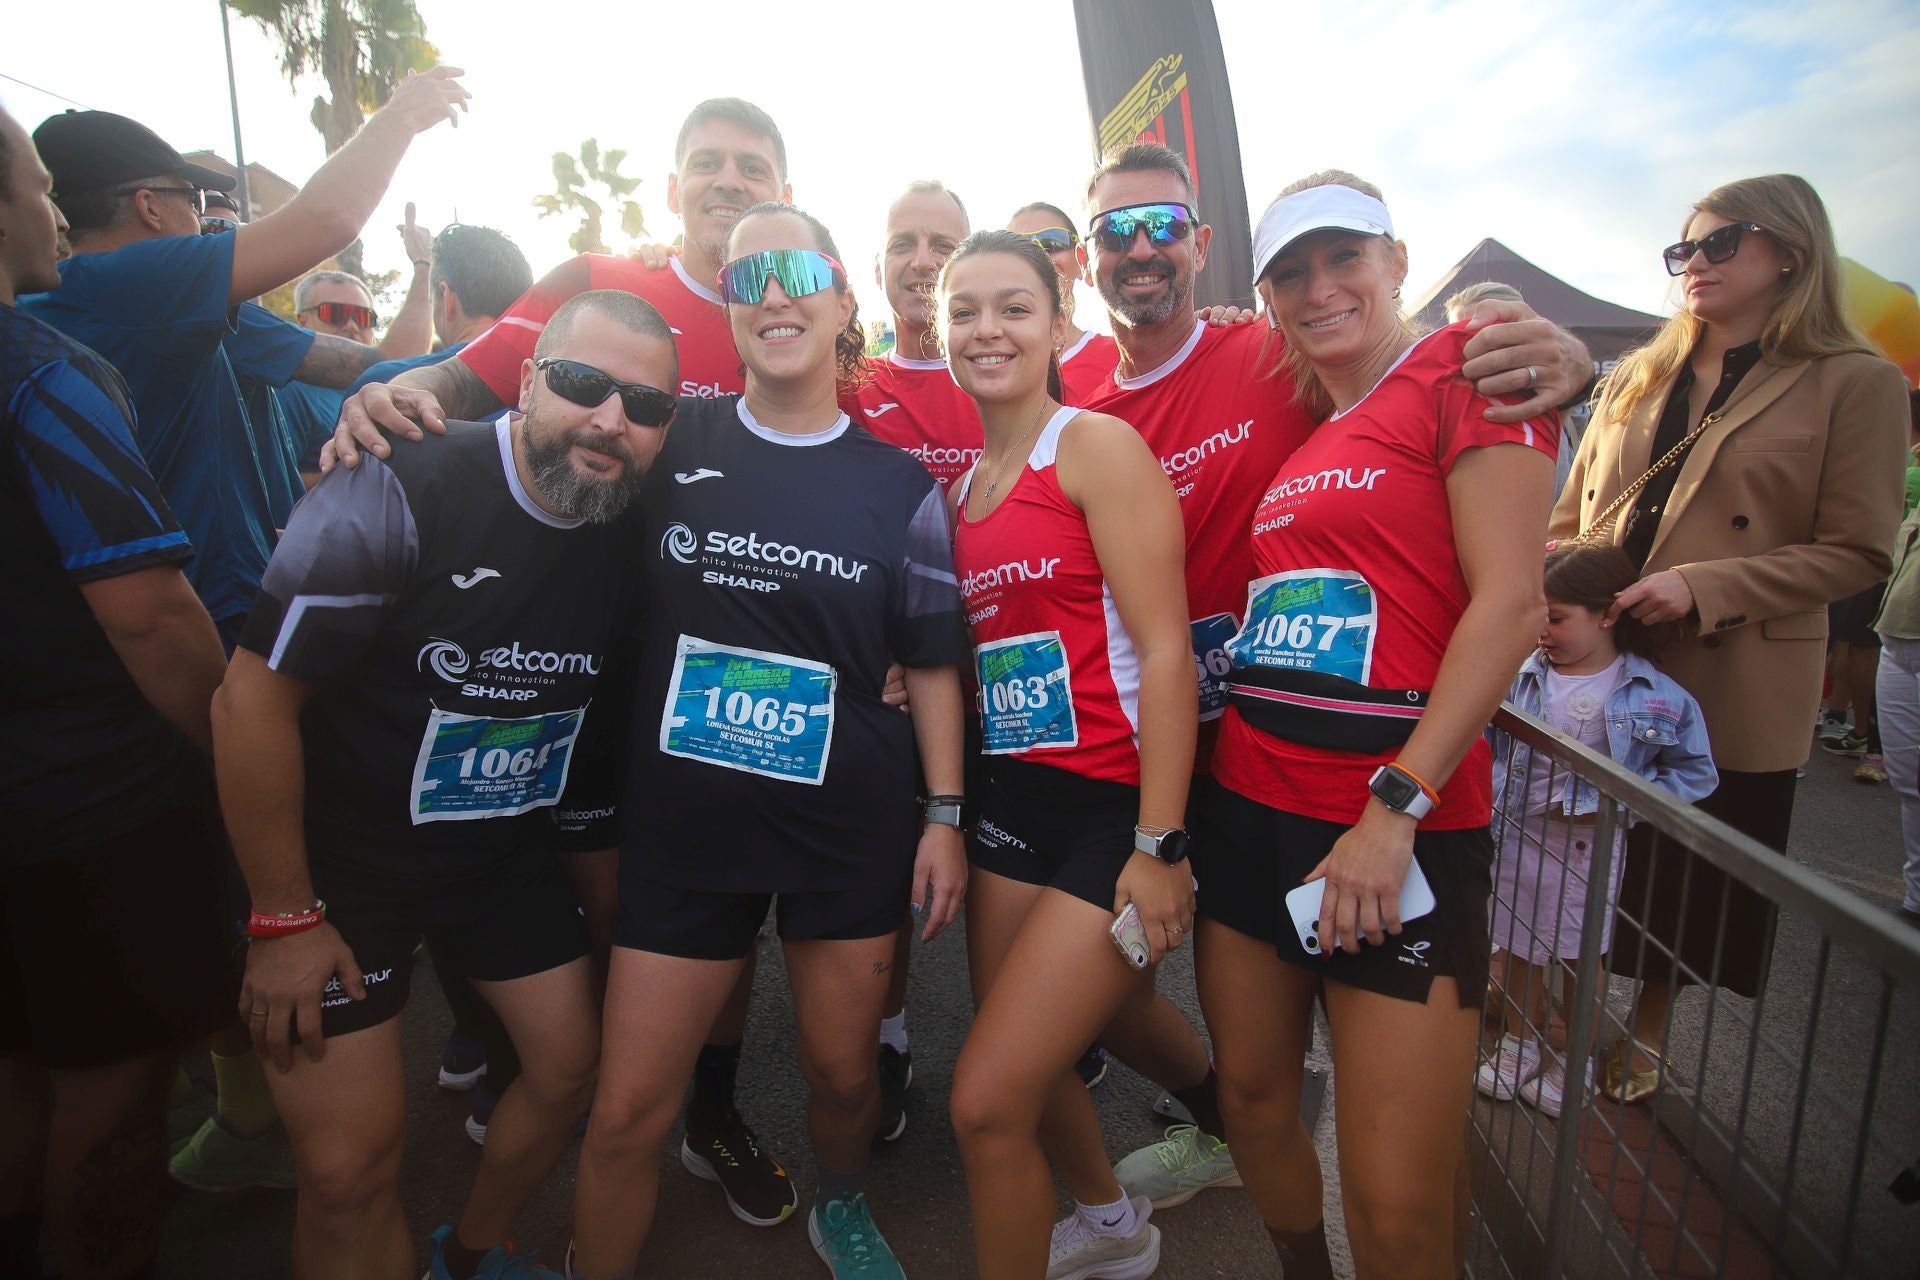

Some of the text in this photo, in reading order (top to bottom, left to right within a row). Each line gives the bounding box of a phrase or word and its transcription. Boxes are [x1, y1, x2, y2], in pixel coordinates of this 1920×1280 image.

[1260, 467, 1386, 508] setcomur
[1253, 513, 1295, 536] SHARP
[701, 556, 799, 579] hito innovation
[704, 531, 868, 583] setcomur
[702, 571, 781, 592] SHARP
[968, 604, 999, 625] SHARP
[1251, 613, 1345, 651] 1067
[1255, 655, 1312, 668] SETCOMUR SL2
[495, 672, 556, 685] innovation
[461, 683, 538, 700] SHARP
[703, 686, 808, 736] 1065
[706, 720, 791, 744] LORENA GONZALEZ NICOLAS
[719, 731, 763, 747] SETCOMUR
[764, 741, 775, 750] SL
[456, 743, 553, 778] 1064
